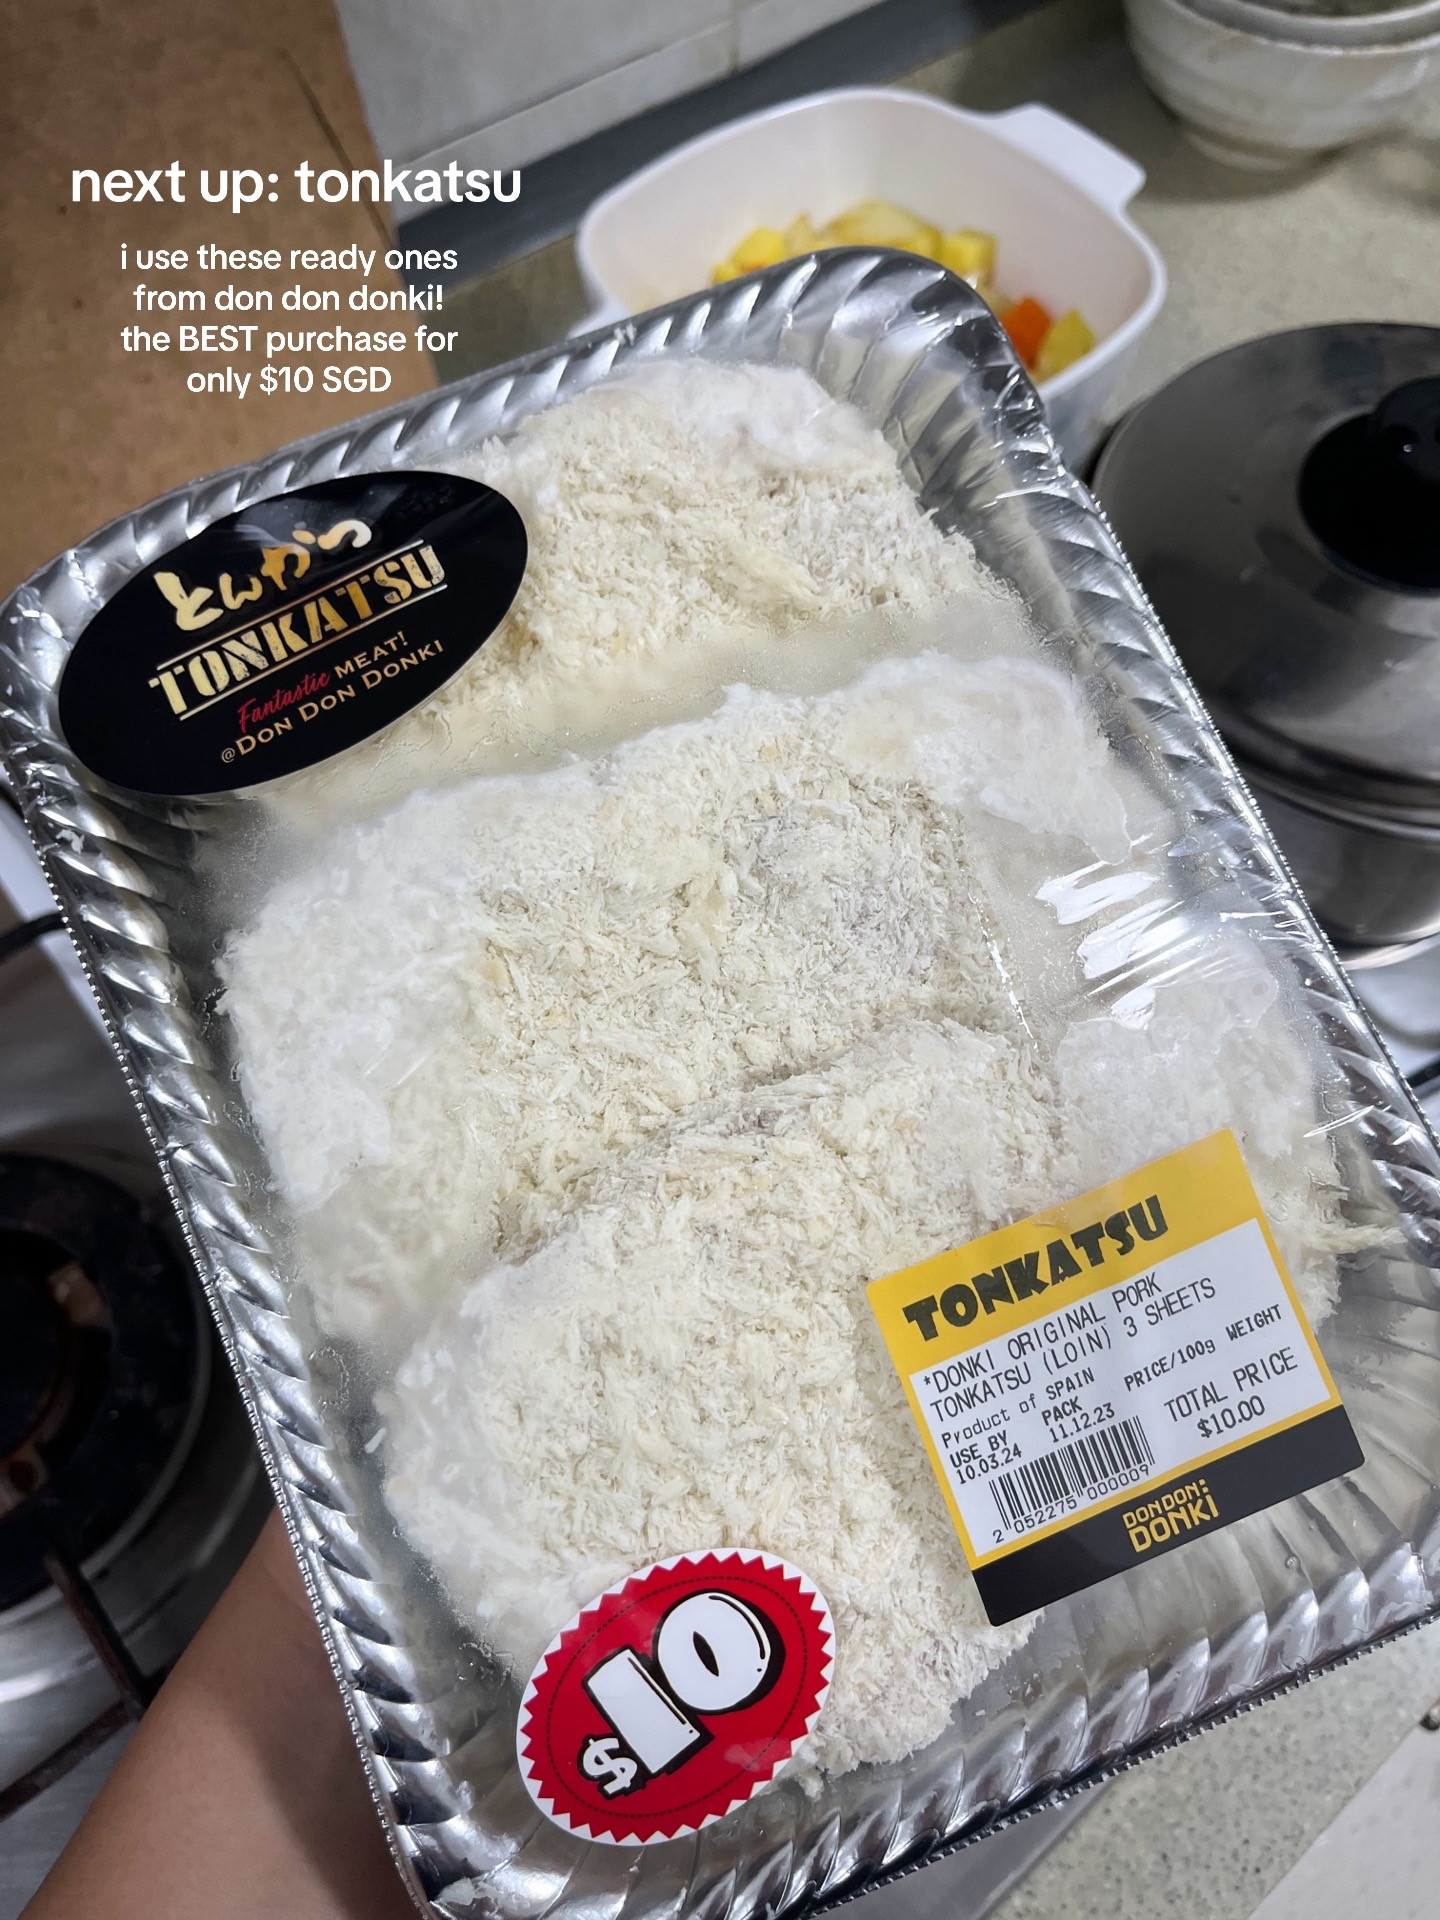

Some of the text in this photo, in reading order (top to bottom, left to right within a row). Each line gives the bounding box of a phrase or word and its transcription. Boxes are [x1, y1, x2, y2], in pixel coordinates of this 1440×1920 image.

[154, 518, 372, 632] とんかつ
[148, 544, 446, 715] TONKATSU
[237, 631, 408, 734] Fantastic MEAT!
[902, 1195, 1169, 1341] TONKATSU
[930, 1278, 1217, 1422] TONKATSU (LOIN) 3 SHEETS
[1006, 1302, 1107, 1359] ORIGINAL
[1111, 1272, 1162, 1312] PORK
[1123, 1305, 1283, 1391] PRICE/100g WEIGHT
[942, 1368, 1095, 1448] Product of SPAIN
[1042, 1397, 1083, 1425] PACK
[1049, 1403, 1115, 1443] 11.12.23
[1164, 1347, 1298, 1423] TOTAL PRICE
[1197, 1396, 1266, 1439] $10.00
[950, 1430, 1008, 1468] USE BY
[957, 1445, 1023, 1484] 10.03.24
[993, 1530, 1004, 1543] 2
[582, 1592, 771, 1794] $10
